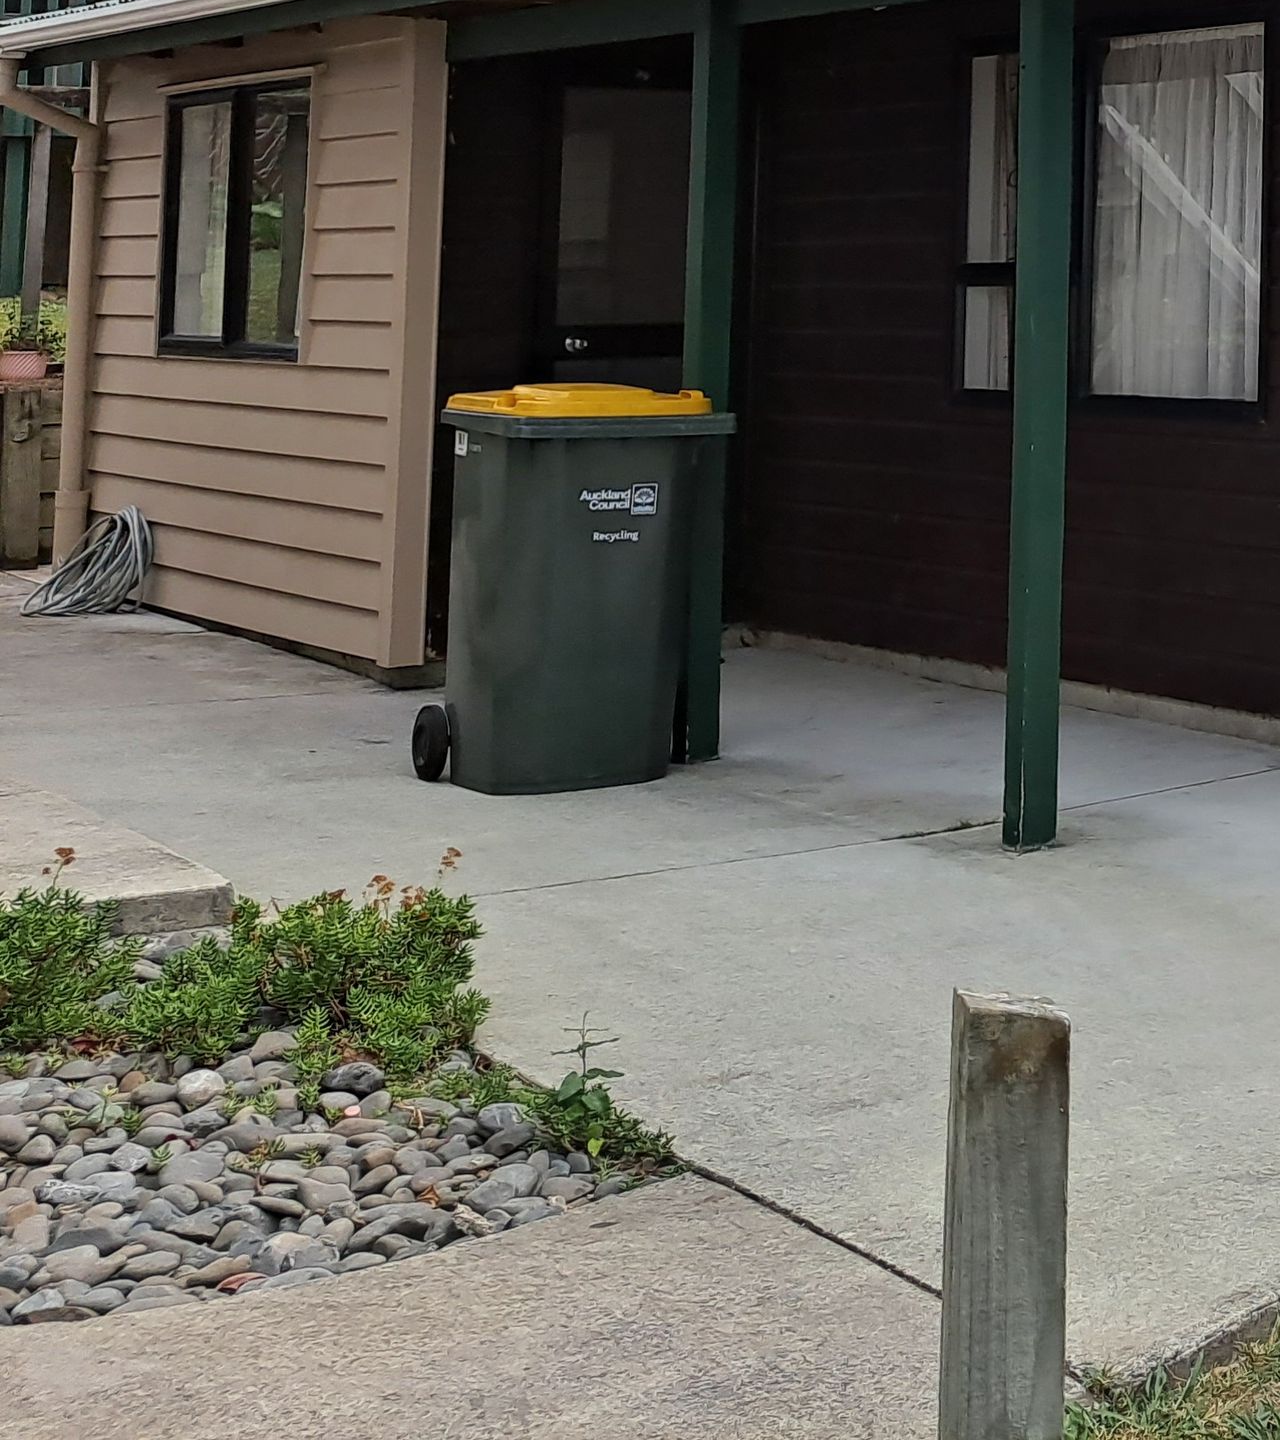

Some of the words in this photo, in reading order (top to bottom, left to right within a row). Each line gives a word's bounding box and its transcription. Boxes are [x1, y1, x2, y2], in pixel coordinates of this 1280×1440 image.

[580, 489, 631, 500] Auckland
[589, 499, 630, 510] Council
[593, 530, 639, 542] Recycling
